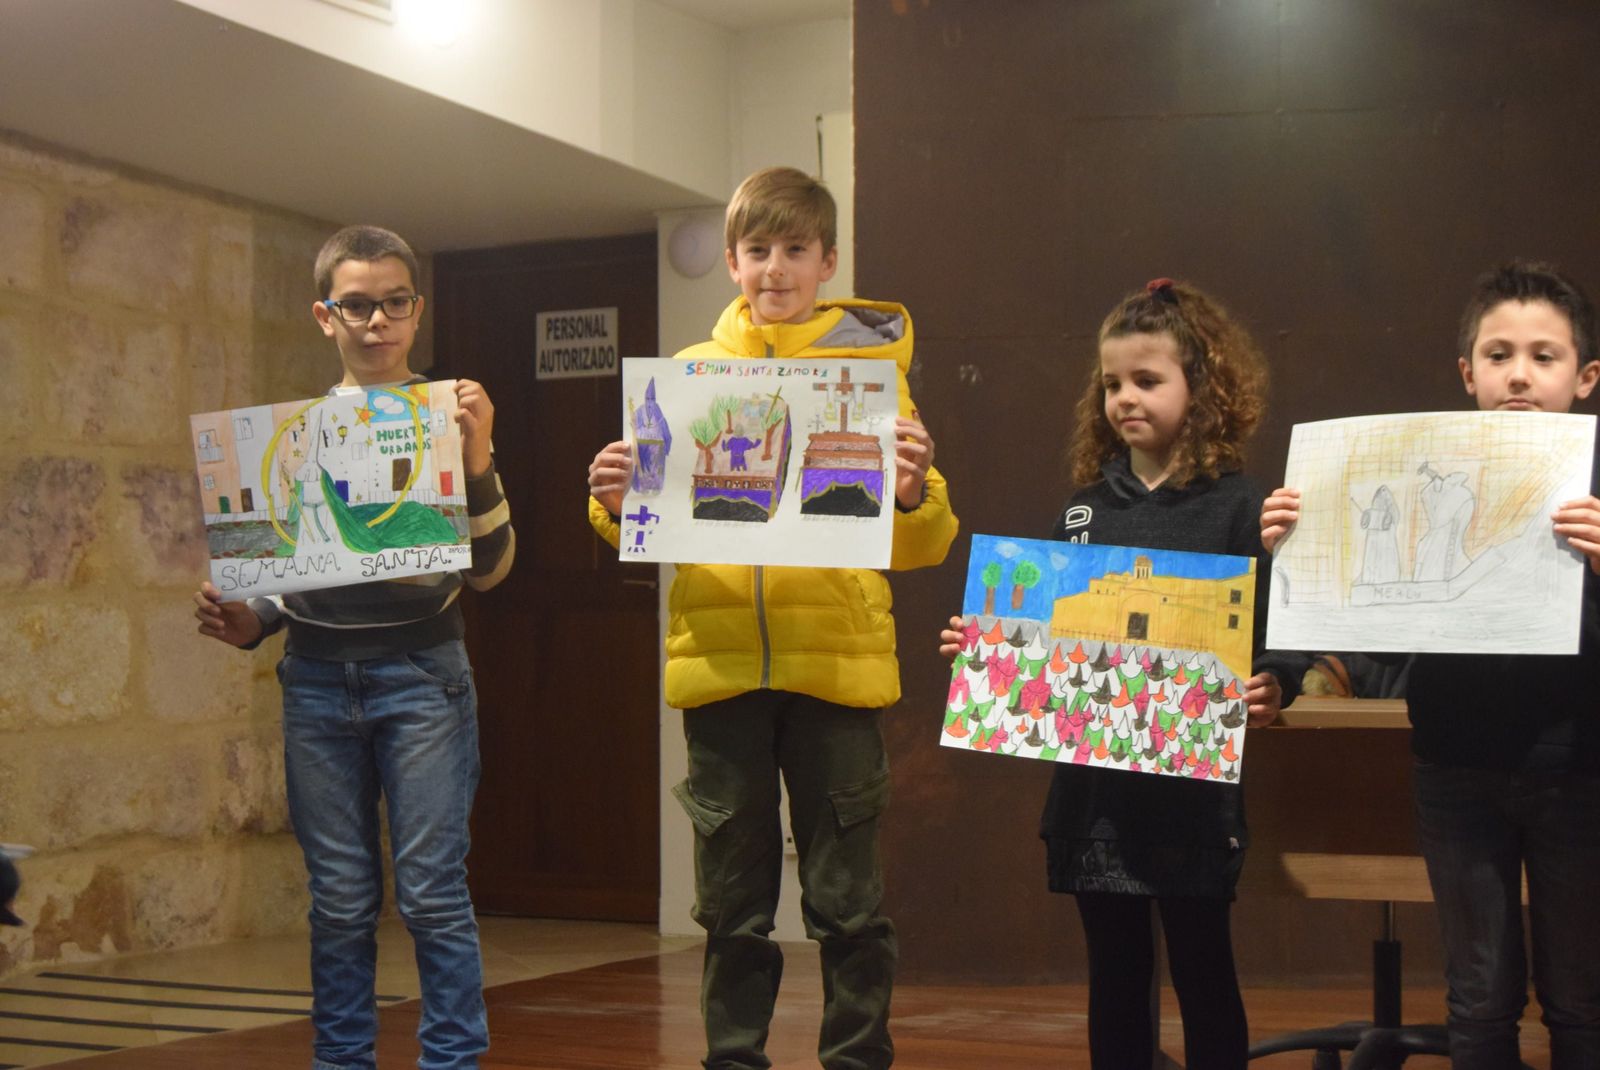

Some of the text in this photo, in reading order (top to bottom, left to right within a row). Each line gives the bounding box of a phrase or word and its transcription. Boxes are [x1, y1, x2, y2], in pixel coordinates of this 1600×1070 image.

[546, 314, 608, 340] PERSONAL
[539, 345, 615, 373] AUTORIZADO
[686, 361, 732, 375] SEMANA
[736, 365, 773, 377] SANTA
[221, 552, 341, 591] SEMANA
